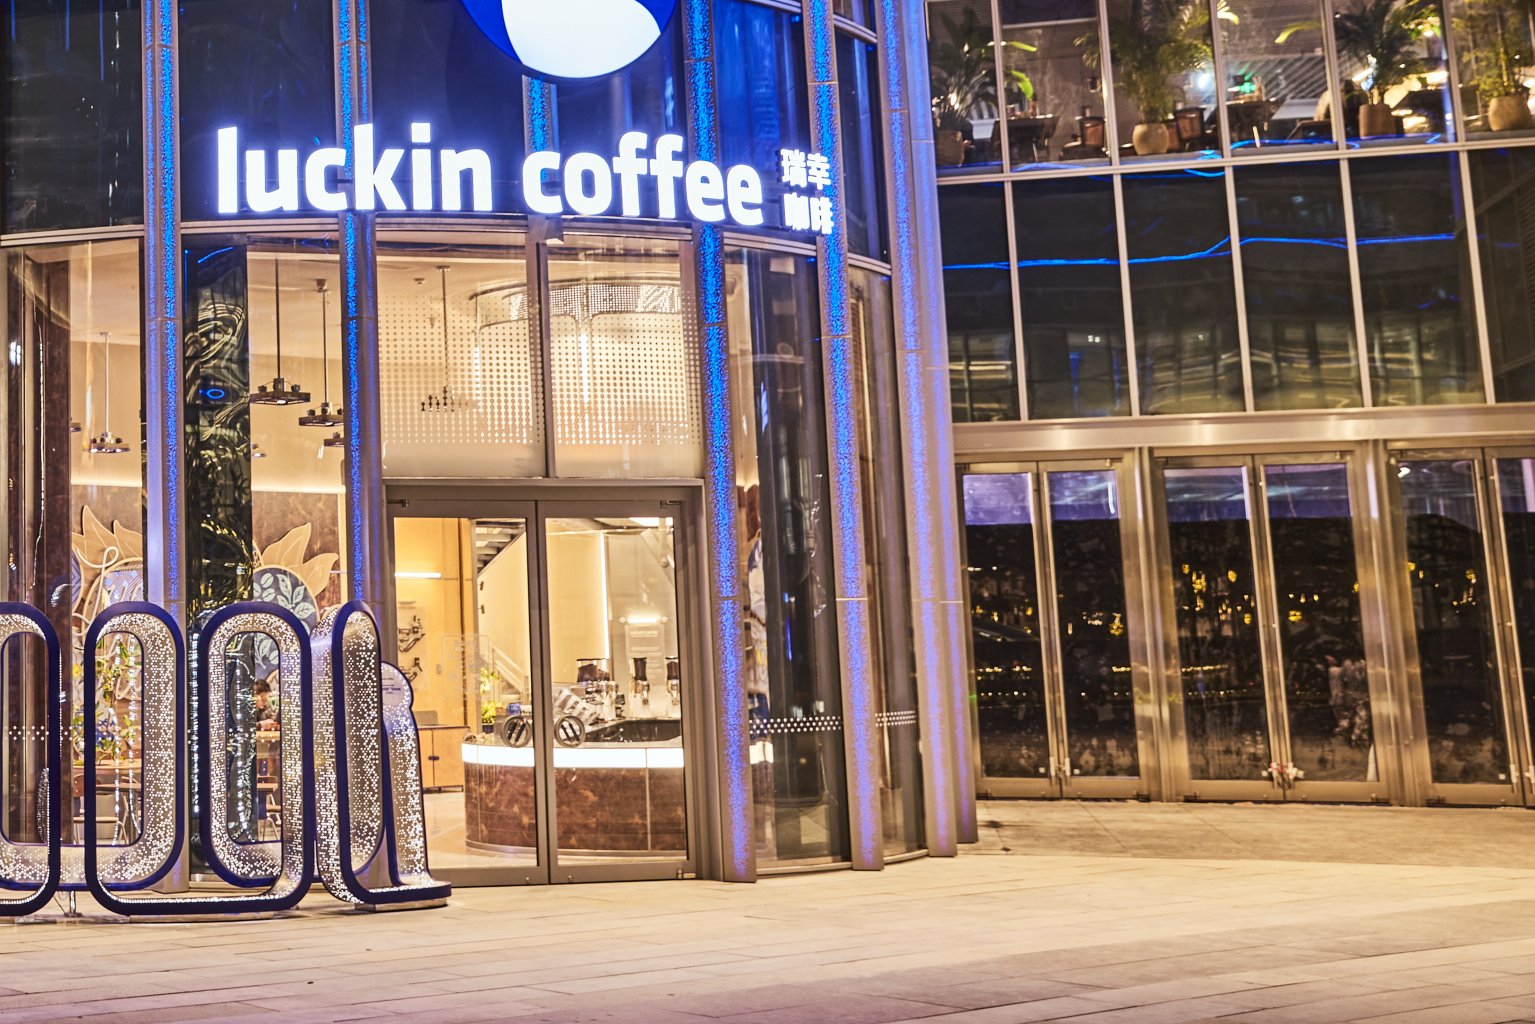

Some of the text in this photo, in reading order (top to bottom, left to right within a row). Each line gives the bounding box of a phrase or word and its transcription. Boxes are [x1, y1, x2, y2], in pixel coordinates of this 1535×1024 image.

[217, 122, 765, 226] luckin coffee
[779, 148, 832, 191] 瑞幸
